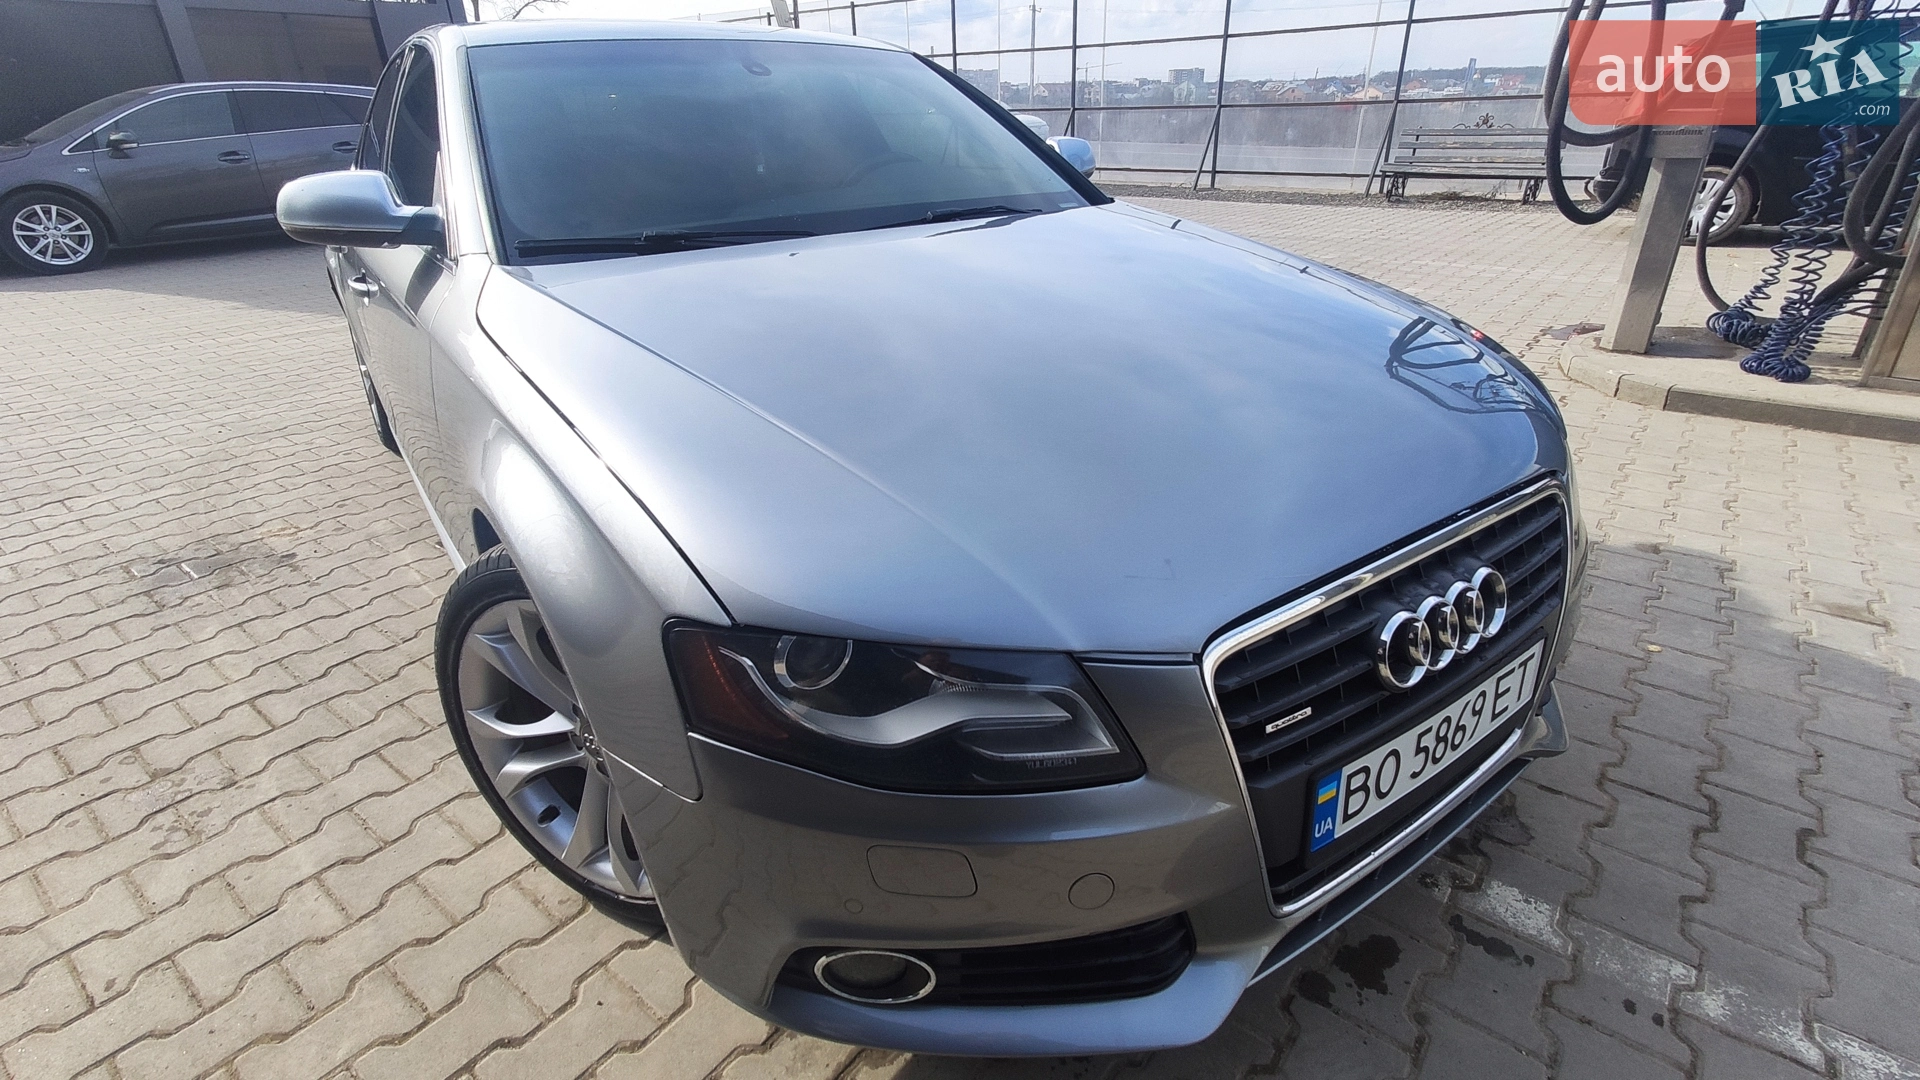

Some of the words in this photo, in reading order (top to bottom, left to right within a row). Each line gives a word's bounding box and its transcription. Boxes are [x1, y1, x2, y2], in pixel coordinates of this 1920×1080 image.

[1270, 711, 1308, 730] quattro
[1342, 749, 1401, 825] BO
[1410, 690, 1487, 780] 5869
[1490, 653, 1536, 723] ET
[1314, 816, 1334, 839] UA
